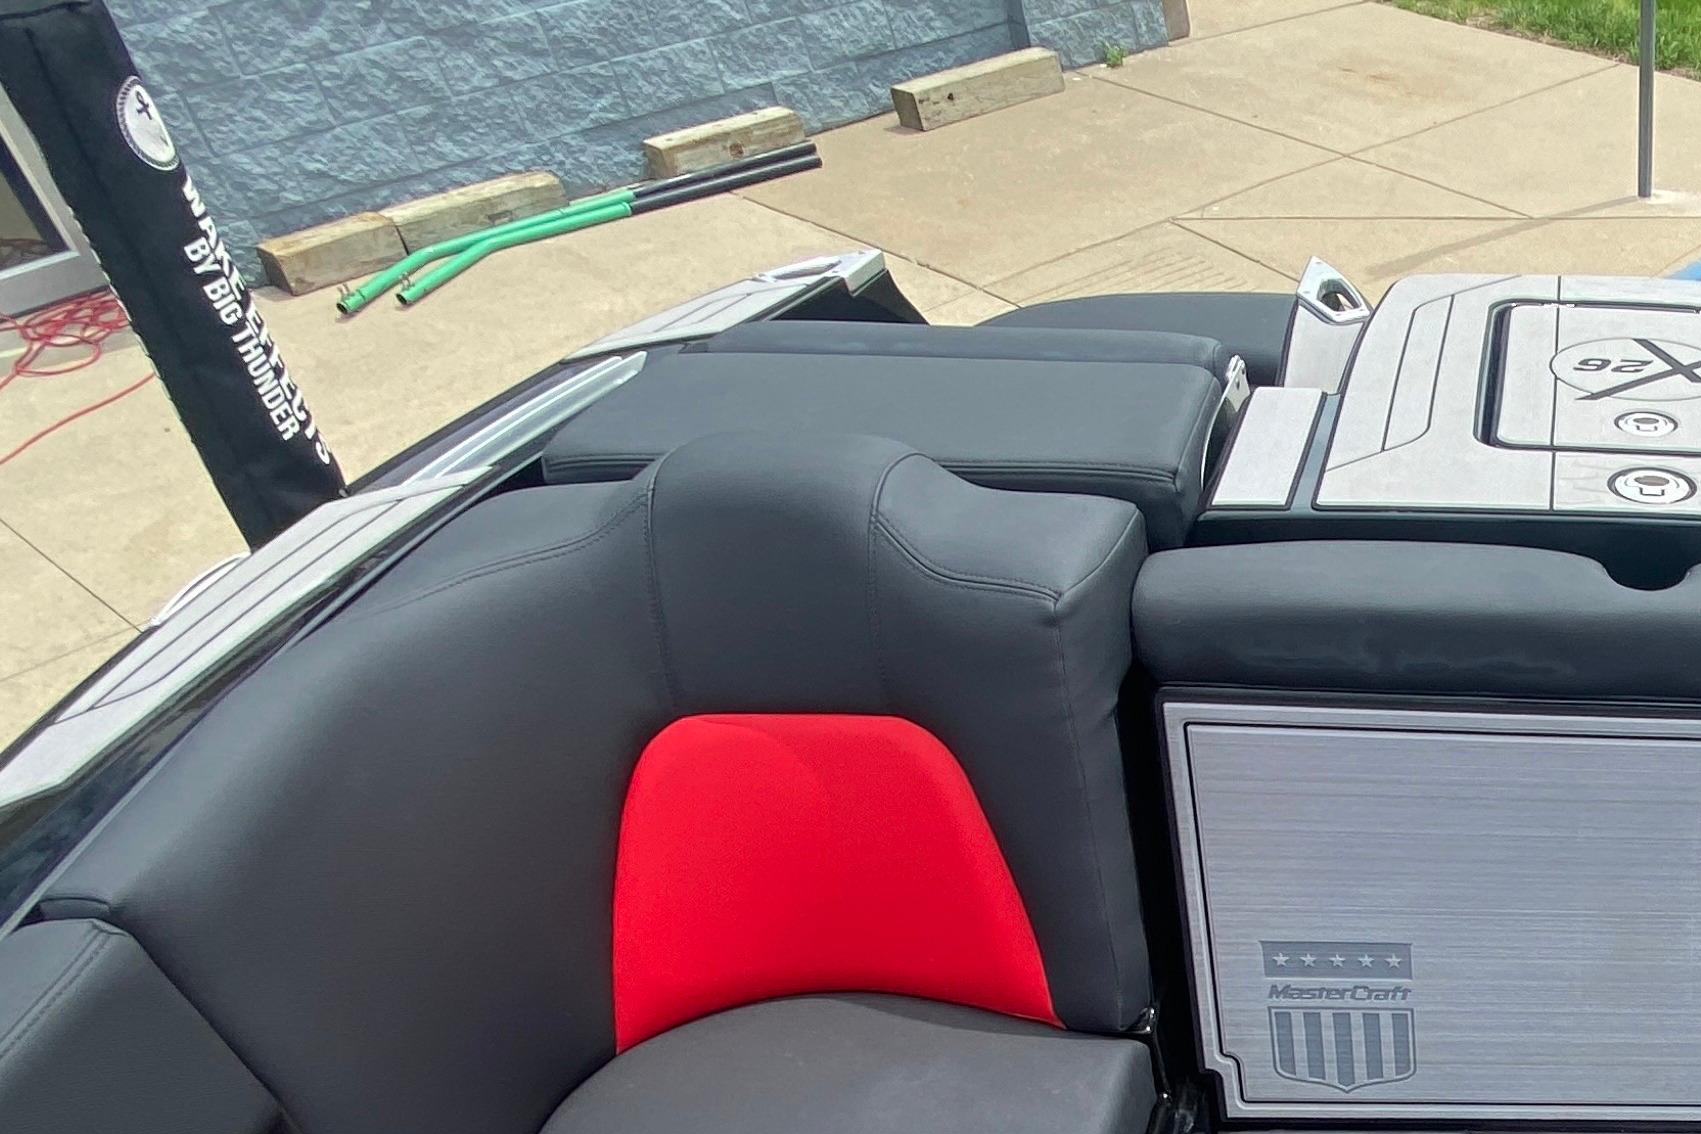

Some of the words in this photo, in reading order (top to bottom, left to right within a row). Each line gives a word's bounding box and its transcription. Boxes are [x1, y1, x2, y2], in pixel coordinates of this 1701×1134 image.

[184, 237, 222, 275] BY
[203, 277, 243, 325] BIG
[232, 320, 301, 441] THUNDER
[1268, 984, 1412, 1001] MasterCraft
